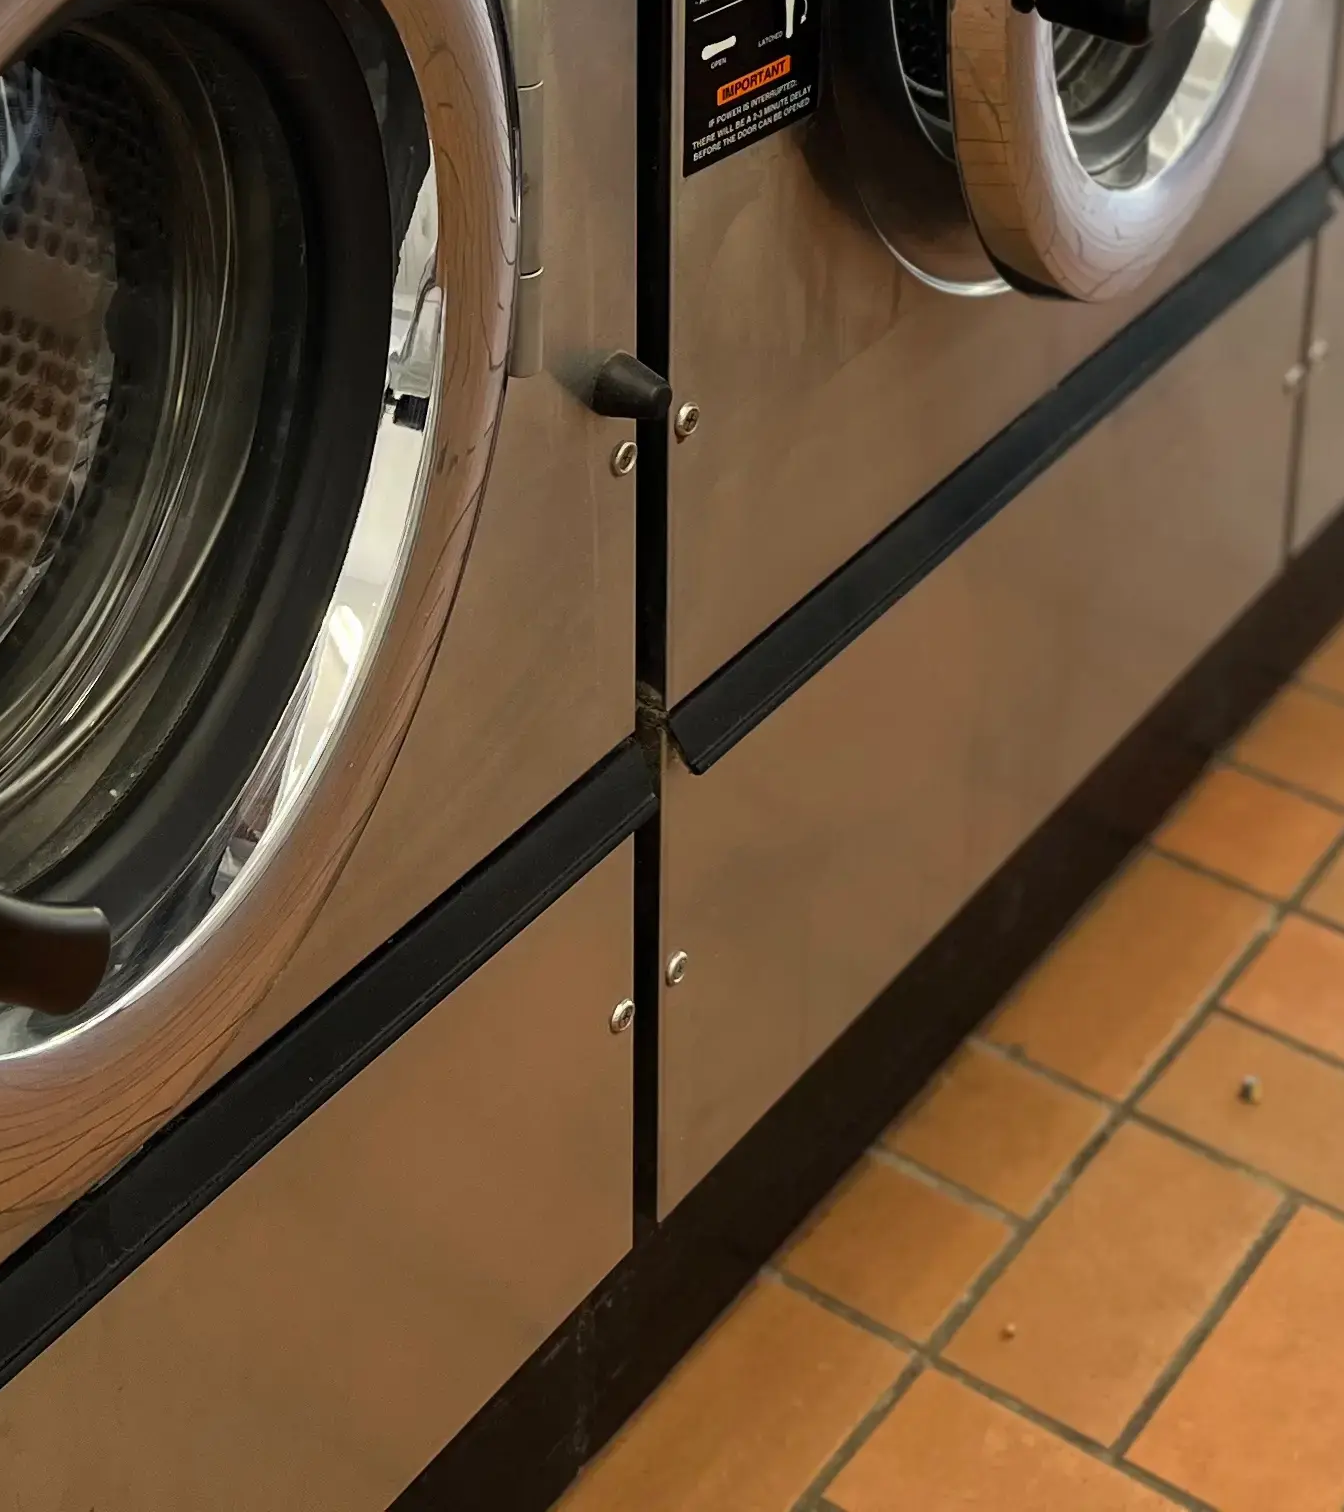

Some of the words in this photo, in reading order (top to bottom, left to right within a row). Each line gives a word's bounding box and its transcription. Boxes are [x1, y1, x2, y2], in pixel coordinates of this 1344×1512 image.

[722, 59, 786, 101] IMPORTANT
[692, 133, 716, 150] THERE
[717, 124, 734, 139] WILL
[735, 118, 745, 129] BE
[746, 114, 752, 124] A
[764, 96, 789, 116] MINUTE
[789, 85, 812, 106] DELAY
[693, 143, 722, 162] BEFORE
[723, 135, 736, 147] THE
[737, 124, 757, 140] DOOR
[758, 117, 773, 130] CAN
[773, 111, 783, 121] BE
[784, 97, 810, 116] OPENED
[708, 120, 715, 129] IF
[716, 106, 742, 125] POWER
[743, 101, 750, 112] IS
